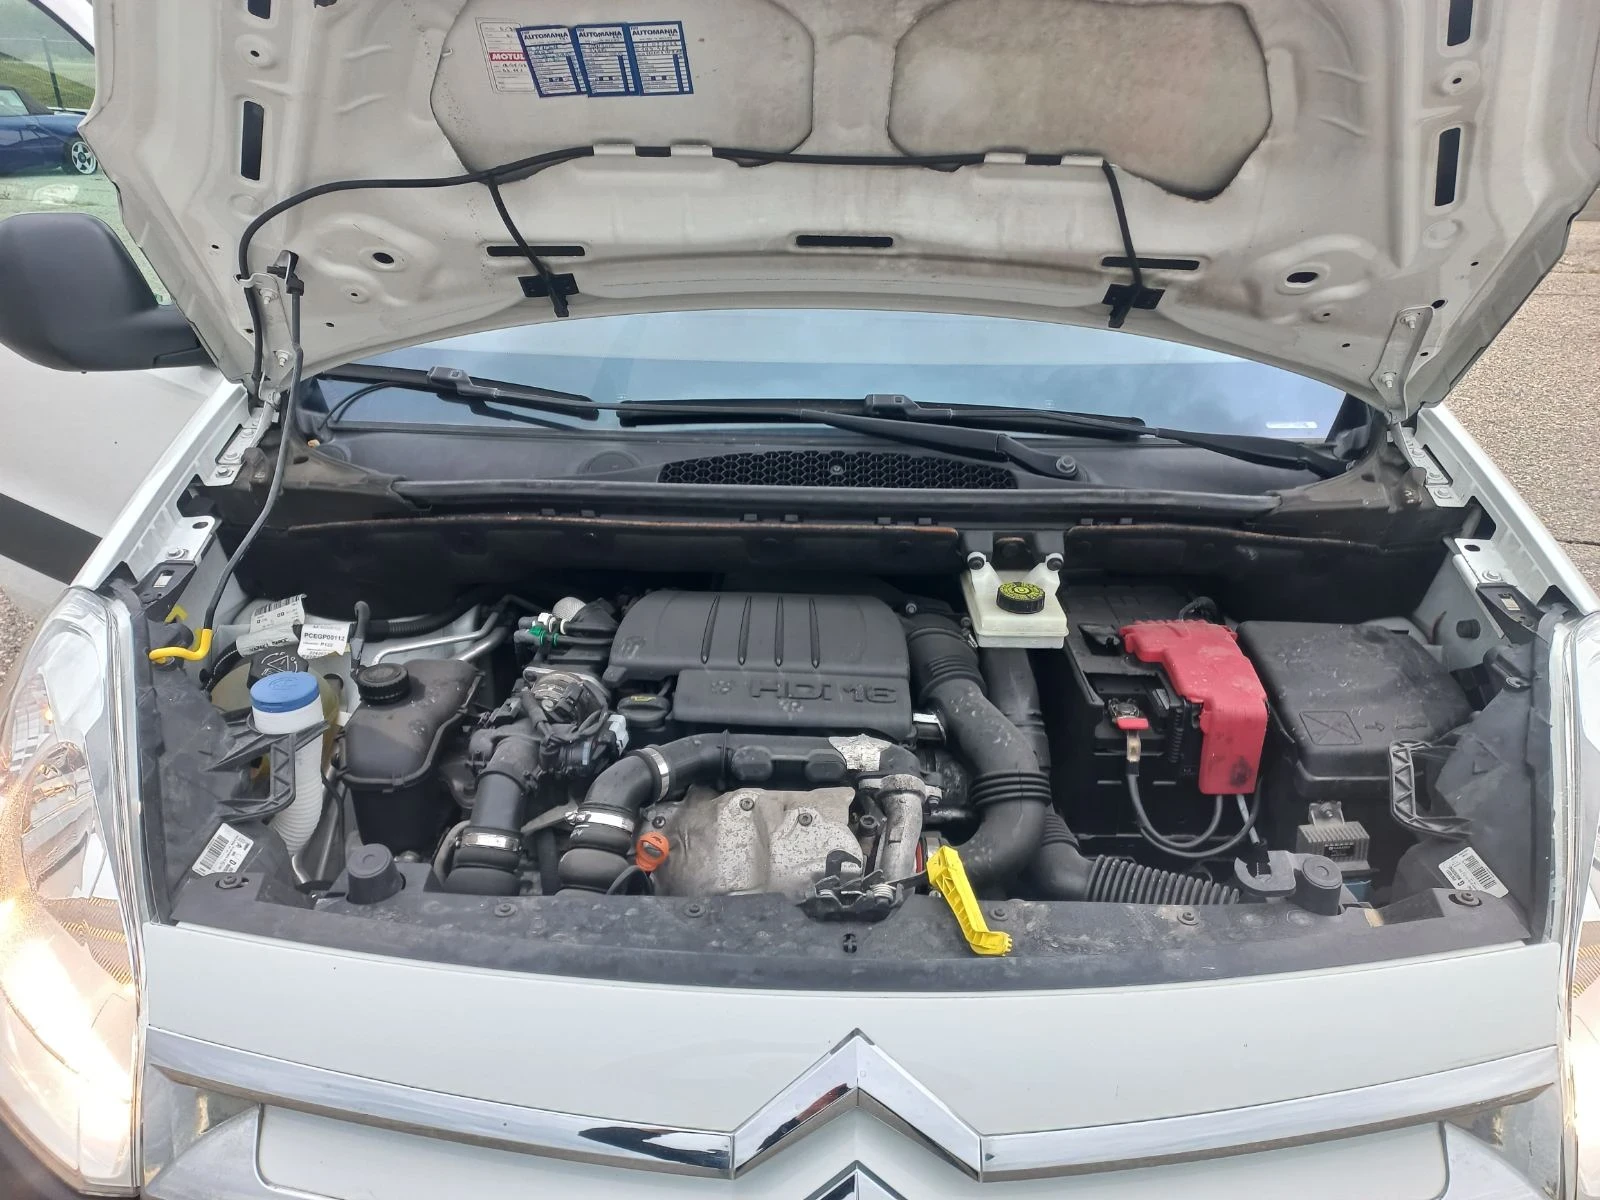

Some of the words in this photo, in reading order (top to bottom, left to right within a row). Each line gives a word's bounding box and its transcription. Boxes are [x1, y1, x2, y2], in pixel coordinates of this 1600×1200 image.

[524, 31, 569, 40] AUTOMANIA
[578, 30, 623, 38] AUTOMANIA
[632, 28, 679, 36] AUTOMANIA
[491, 52, 526, 60] MOTUL
